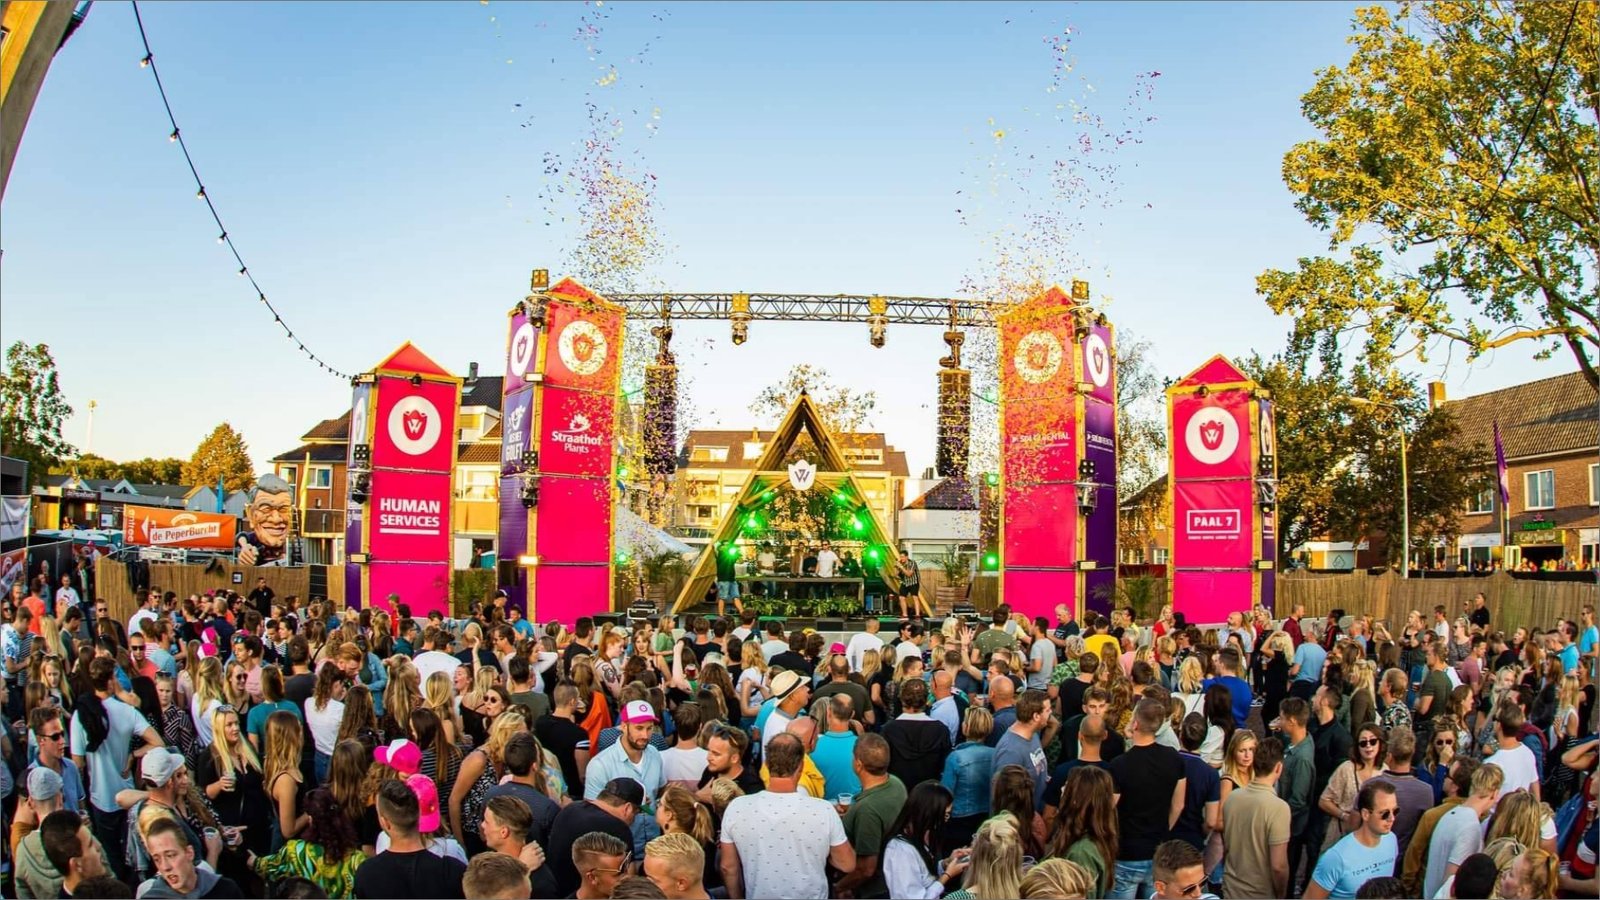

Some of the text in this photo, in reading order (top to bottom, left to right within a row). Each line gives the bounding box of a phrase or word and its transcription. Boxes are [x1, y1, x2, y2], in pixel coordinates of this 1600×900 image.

[407, 418, 423, 434] W
[551, 430, 602, 446] Straathof
[1204, 428, 1220, 444] W
[563, 443, 590, 454] Plants
[794, 468, 810, 483] W
[379, 497, 441, 514] HUMAN
[379, 514, 440, 527] SERVICES
[1193, 516, 1233, 527] PAAL 7
[152, 530, 163, 542] de
